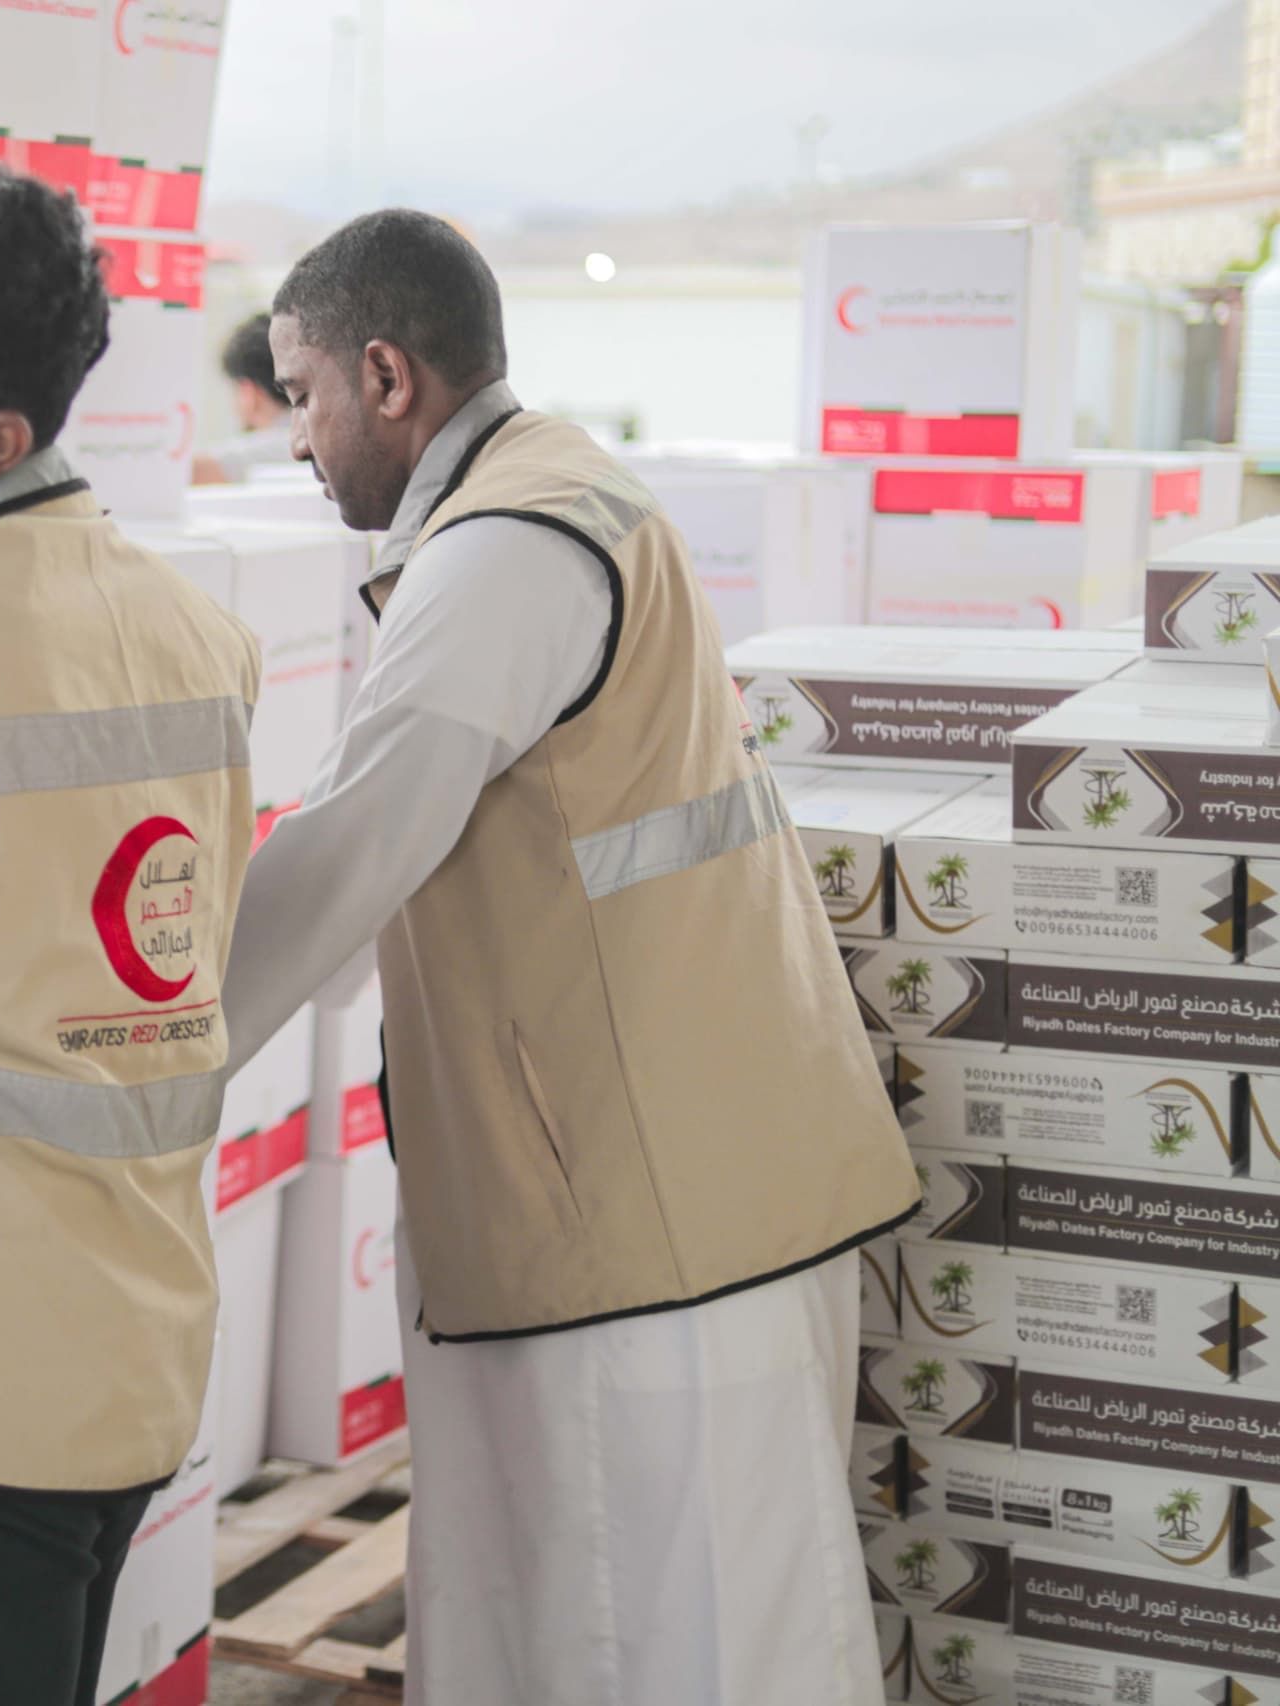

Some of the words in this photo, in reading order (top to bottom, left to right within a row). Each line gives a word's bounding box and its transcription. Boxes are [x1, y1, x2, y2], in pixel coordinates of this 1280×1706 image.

[851, 694, 896, 712] Industry
[899, 697, 913, 713] for
[915, 697, 968, 715] Company
[970, 699, 1012, 716] Factory
[1200, 769, 1253, 787] Industry
[1256, 775, 1274, 789] for
[1200, 800, 1257, 823] شركة
[1021, 982, 1081, 1004] للصناعة
[1084, 987, 1139, 1013] الرياض
[1141, 994, 1177, 1014] تمور
[1181, 994, 1228, 1019] مصنع
[57, 1027, 127, 1052] EMIRATES
[129, 1024, 159, 1044] RED
[1023, 1016, 1063, 1032] Riyadh
[1066, 1019, 1101, 1034] Dates
[1104, 1022, 1151, 1041] Factory
[1153, 1026, 1212, 1046] Company
[1215, 1030, 1232, 1044] for
[1235, 1033, 1280, 1048] Industr
[1018, 1184, 1077, 1207] للصناعة
[1079, 1192, 1133, 1217] الرياض
[1136, 1199, 1172, 1219] تمور
[1174, 1202, 1222, 1226] مصنع
[1224, 1207, 1279, 1230] شركة
[1019, 1215, 1059, 1233] Riyadh
[1061, 1219, 1096, 1236] Dates
[1098, 1224, 1145, 1244] Factory
[1147, 1231, 1205, 1252] Company
[1207, 1236, 1225, 1251] for
[1228, 1240, 1280, 1260] Industry
[1032, 1389, 1091, 1413] للصناعة
[1093, 1399, 1147, 1424] الرياض
[1150, 1408, 1184, 1428] تمور
[1188, 1411, 1236, 1434] مصنع
[1033, 1421, 1074, 1440] Riyadh
[1076, 1425, 1110, 1443] Dates
[1113, 1432, 1159, 1451] Factory
[1161, 1438, 1219, 1459] Company
[1221, 1446, 1239, 1459] for
[1242, 1449, 1280, 1466] Indust
[1026, 1577, 1085, 1602] للصناعة
[1086, 1589, 1139, 1614] الرياض
[1141, 1598, 1177, 1618] تمور
[1180, 1603, 1227, 1627] مصنع
[1228, 1610, 1280, 1633] شركة
[1026, 1608, 1067, 1626] Riyadh
[1069, 1615, 1103, 1633] Dates
[1105, 1621, 1152, 1642] Factory
[1153, 1629, 1210, 1652] Company
[1211, 1638, 1230, 1652] for
